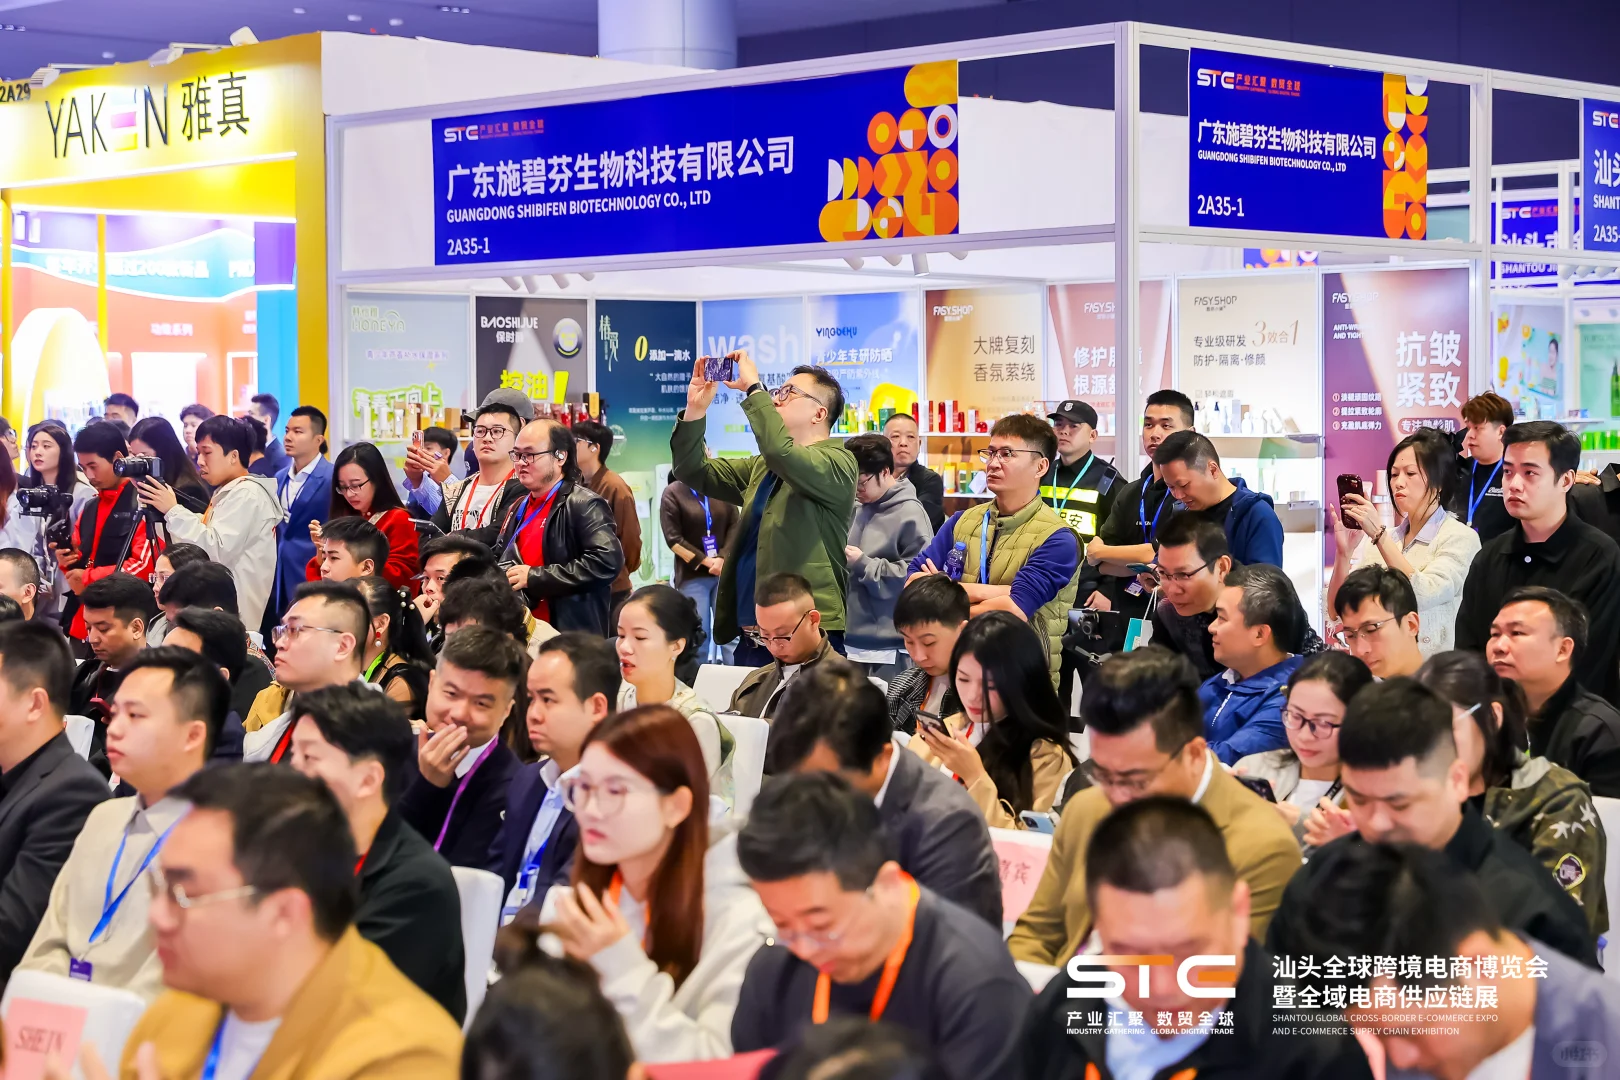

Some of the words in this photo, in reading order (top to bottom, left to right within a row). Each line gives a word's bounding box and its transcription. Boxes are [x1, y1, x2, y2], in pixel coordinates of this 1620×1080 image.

[0, 82, 31, 103] 2A29
[181, 71, 249, 141] 雅真
[1197, 118, 1377, 160] 广东施碧芬生物科技有限公司
[446, 135, 795, 202] 广东施碧芬生物科技有限公司
[1197, 149, 1239, 163] GUANGDONG
[1239, 152, 1269, 166] SHIBIFEN
[1269, 156, 1321, 171] BIOTECHNOLOGY
[1335, 161, 1347, 173] LTD
[447, 203, 515, 223] GUANGDONG
[517, 199, 567, 219] SHIBIFEN
[569, 193, 661, 216] BIOTECHNOLOGY
[663, 192, 688, 210] CO.,
[690, 189, 711, 205] LTD
[1197, 194, 1245, 217] 2A35-1
[447, 237, 490, 256] 2A35-1
[973, 335, 1035, 355] 大牌复刻
[1193, 335, 1247, 348] 专业级研发
[1396, 330, 1462, 367] 抗皱
[973, 362, 1035, 382] 香氛萦绕
[1396, 372, 1462, 408] 紧致
